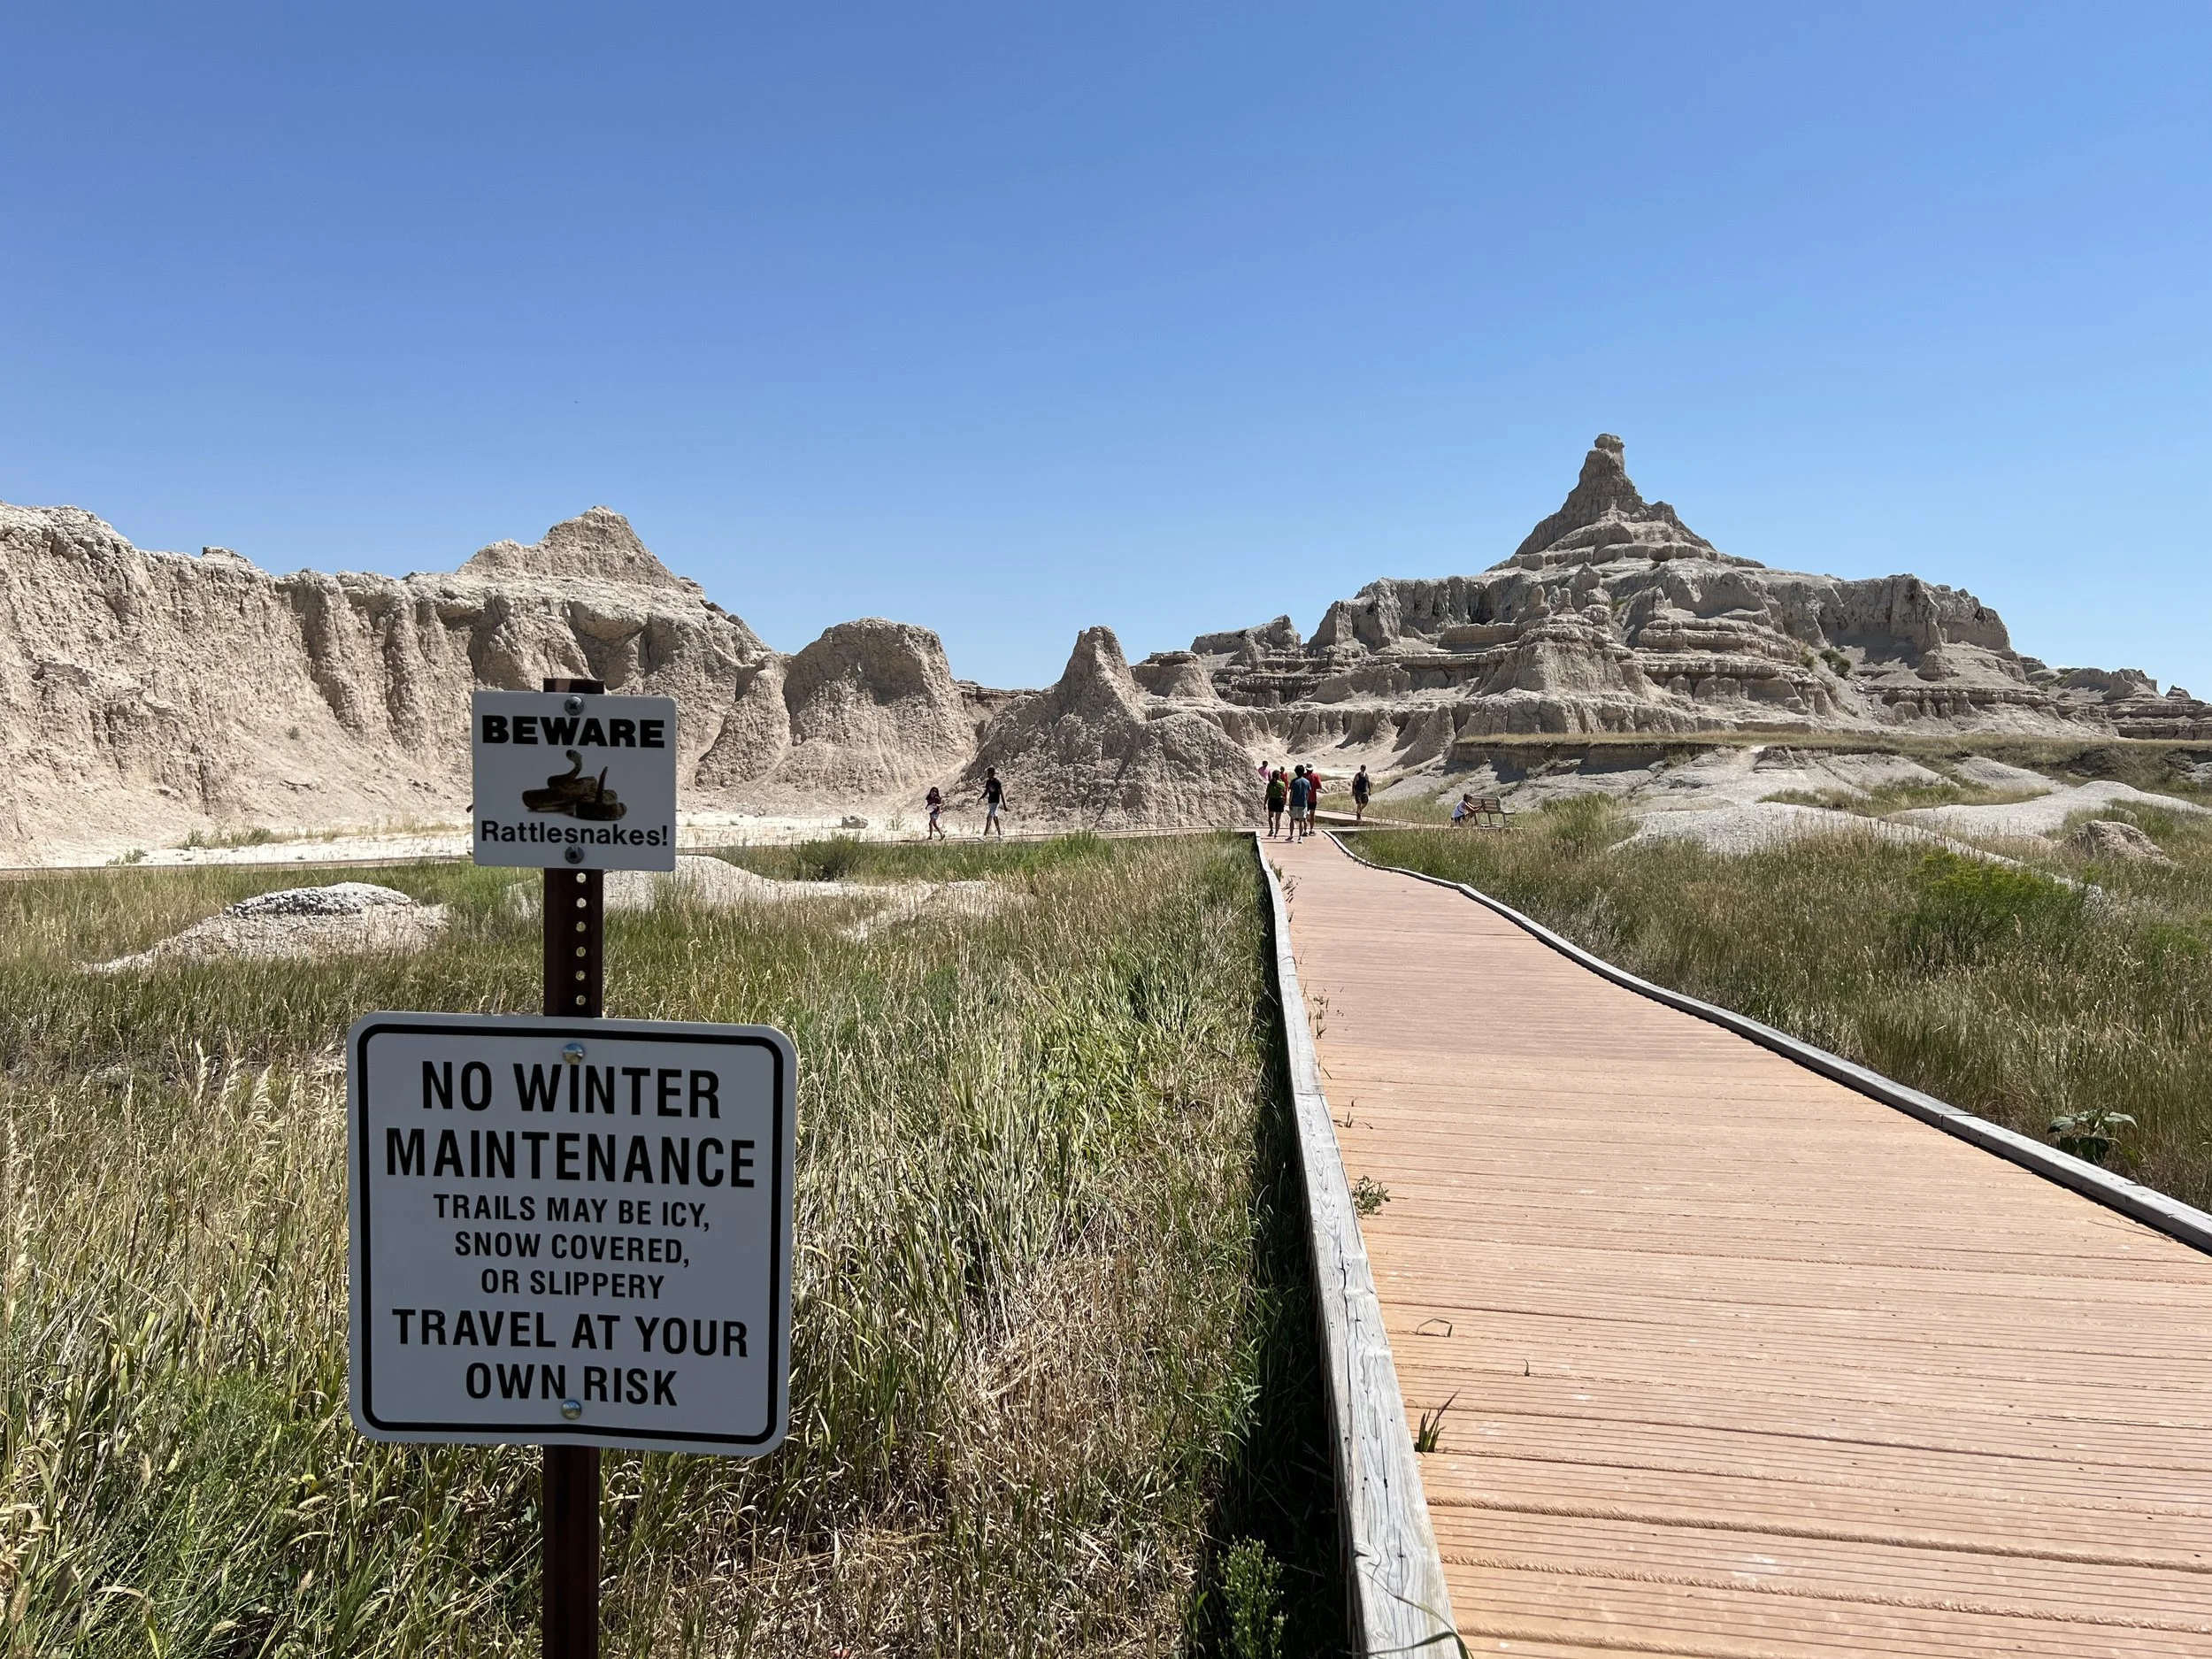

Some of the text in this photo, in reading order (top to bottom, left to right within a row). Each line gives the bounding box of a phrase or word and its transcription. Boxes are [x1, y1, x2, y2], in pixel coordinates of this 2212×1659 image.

[482, 715, 664, 749] BEWARE
[481, 820, 667, 846] Rattlesnakes!
[422, 1061, 721, 1118] NO WINTER
[387, 1127, 755, 1188] MAINTENANCE
[434, 1194, 710, 1232] TRAILS MAY BE ICY,
[455, 1232, 689, 1267] SNOW COVERED,
[481, 1269, 664, 1300] OR SLIPPERY
[392, 1309, 749, 1357] TRAVEL AT YOUR
[466, 1363, 678, 1406] OWN RISK
